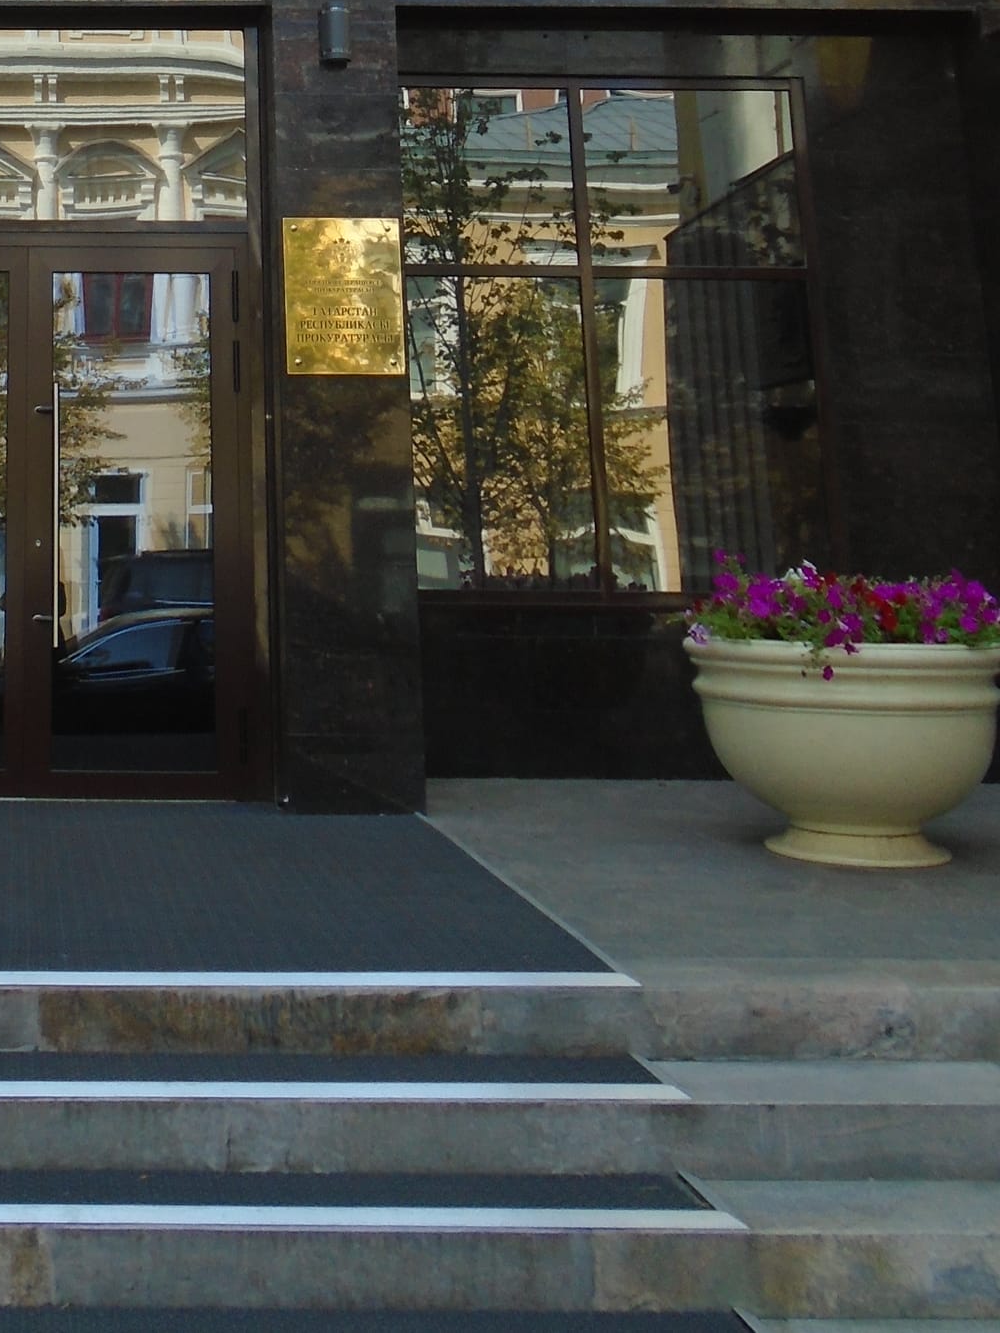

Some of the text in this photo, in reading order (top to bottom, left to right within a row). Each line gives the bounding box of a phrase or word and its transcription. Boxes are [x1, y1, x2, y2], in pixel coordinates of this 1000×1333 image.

[313, 306, 377, 316] ТАТАРСТАН
[300, 320, 389, 330] РЕСПУБЛИКАСЫ
[297, 334, 393, 343] ПРОКУРАТУРАСЫ
